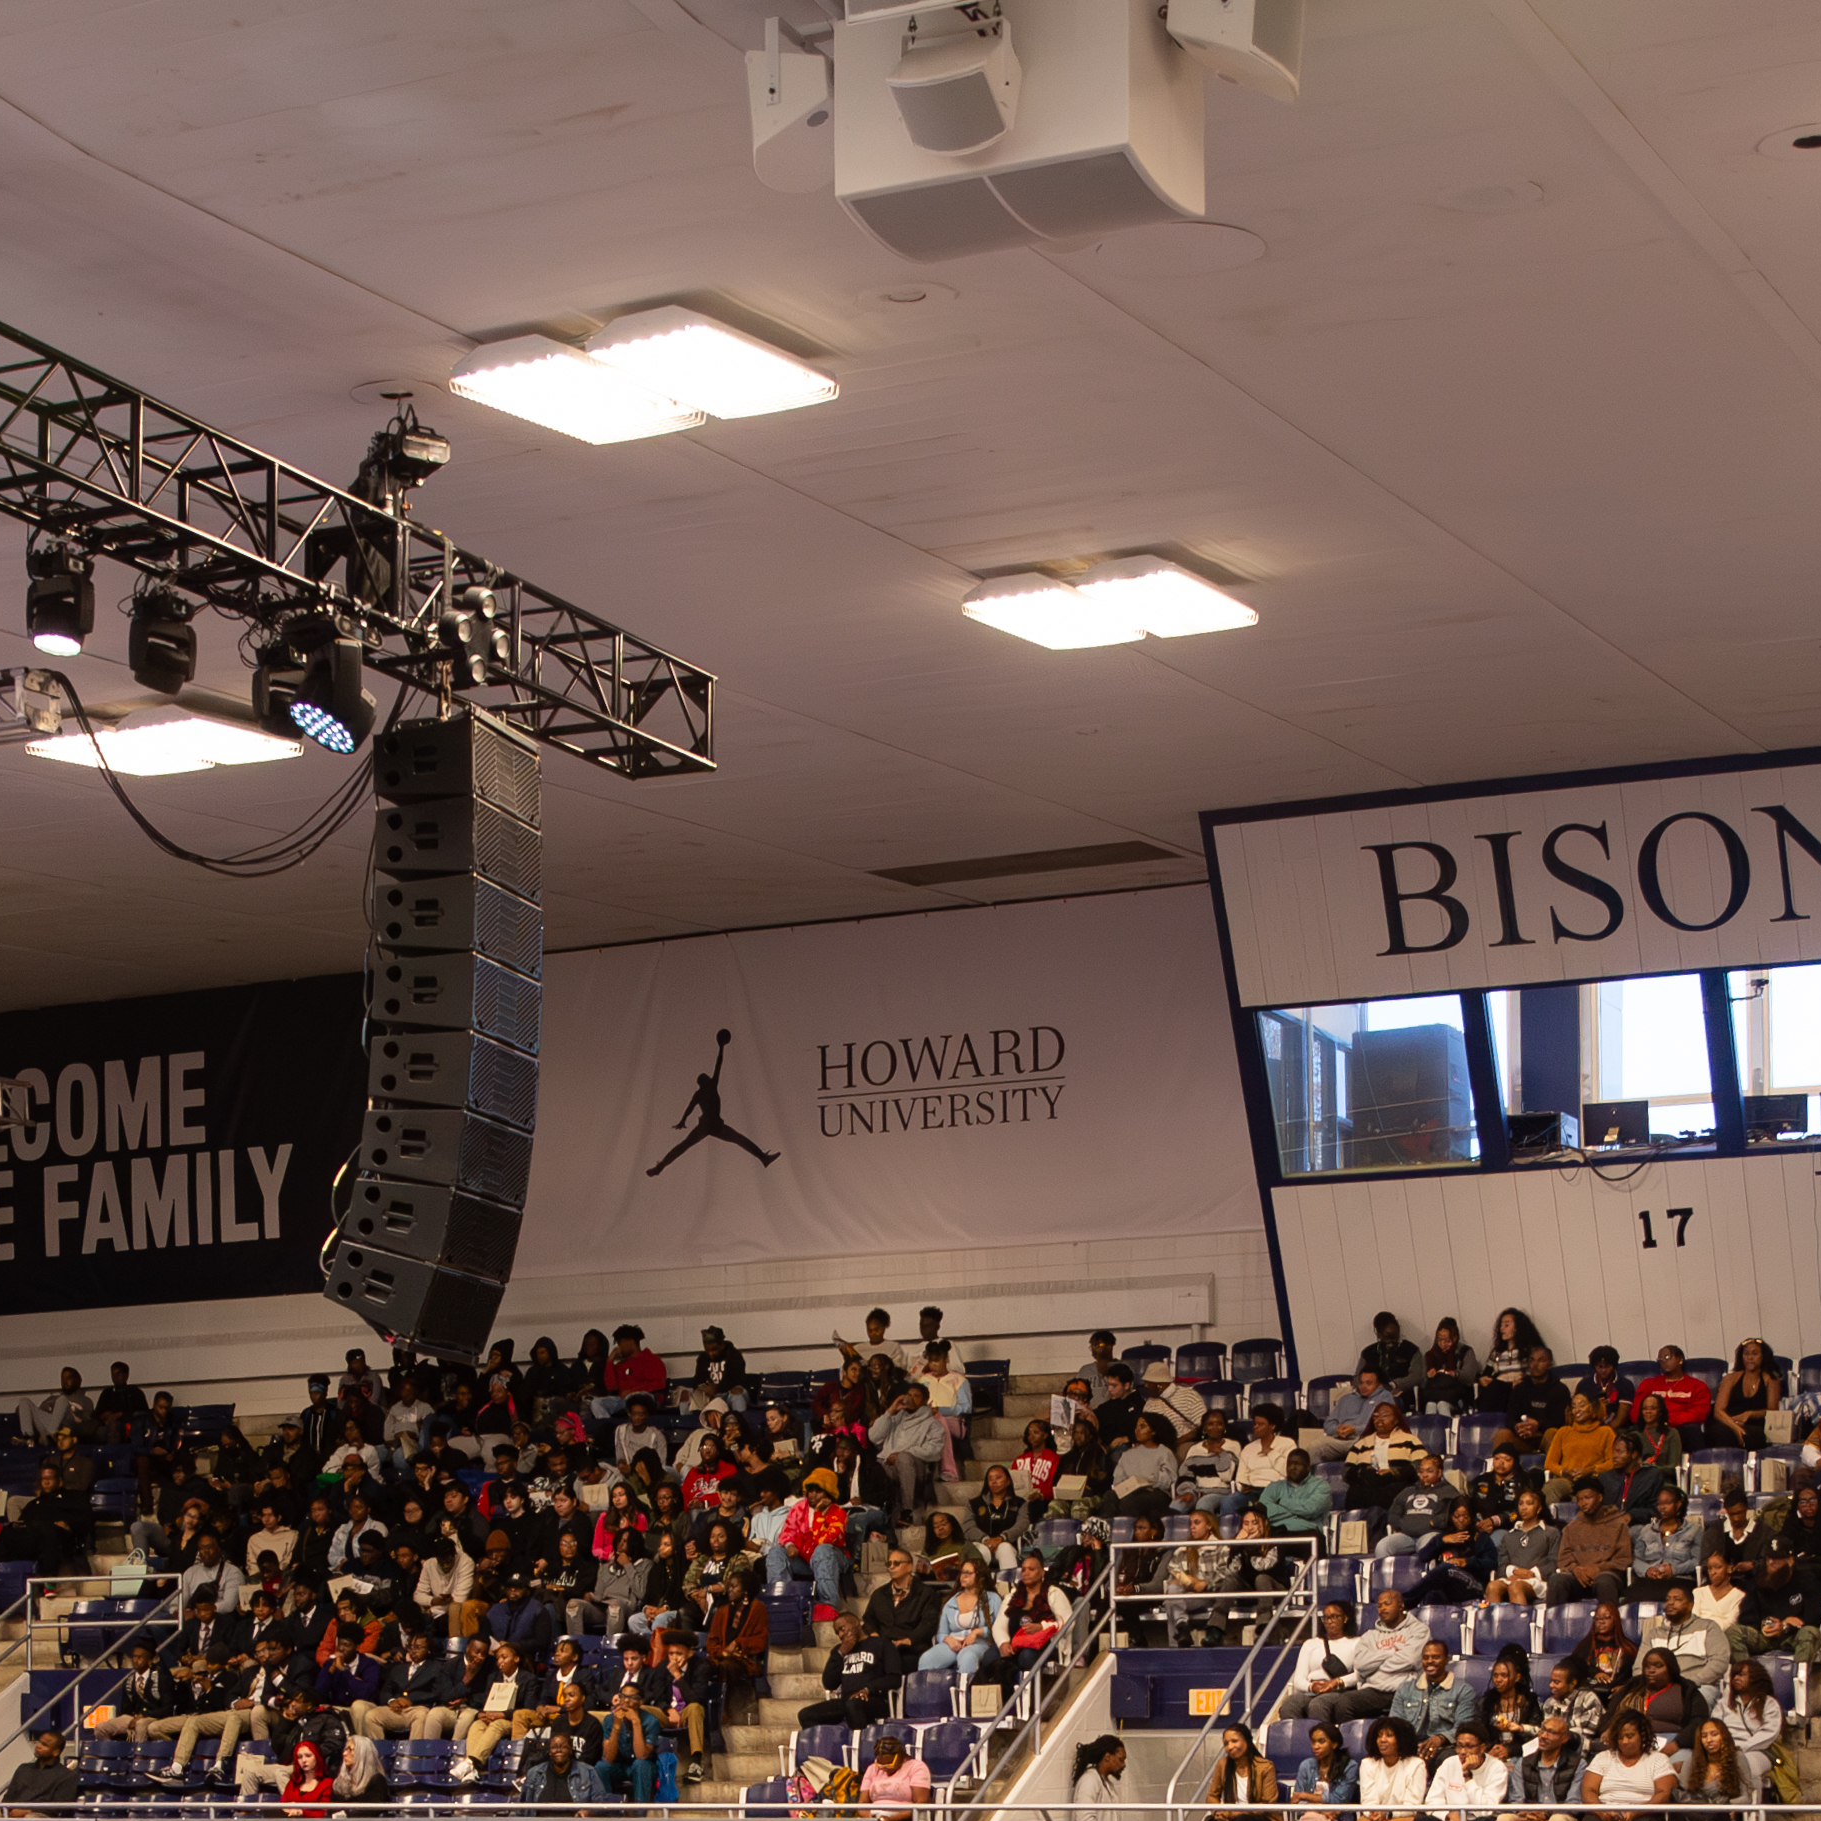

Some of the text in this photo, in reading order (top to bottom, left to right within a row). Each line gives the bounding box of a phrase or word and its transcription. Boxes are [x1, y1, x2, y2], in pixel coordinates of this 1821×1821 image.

[816, 1026, 1066, 1092] HOWARD
[816, 1085, 1066, 1138] UNIVERSITY
[43, 1143, 294, 1258] FAMILY
[1636, 1206, 1695, 1252] 17
[842, 1650, 874, 1666] OWARD
